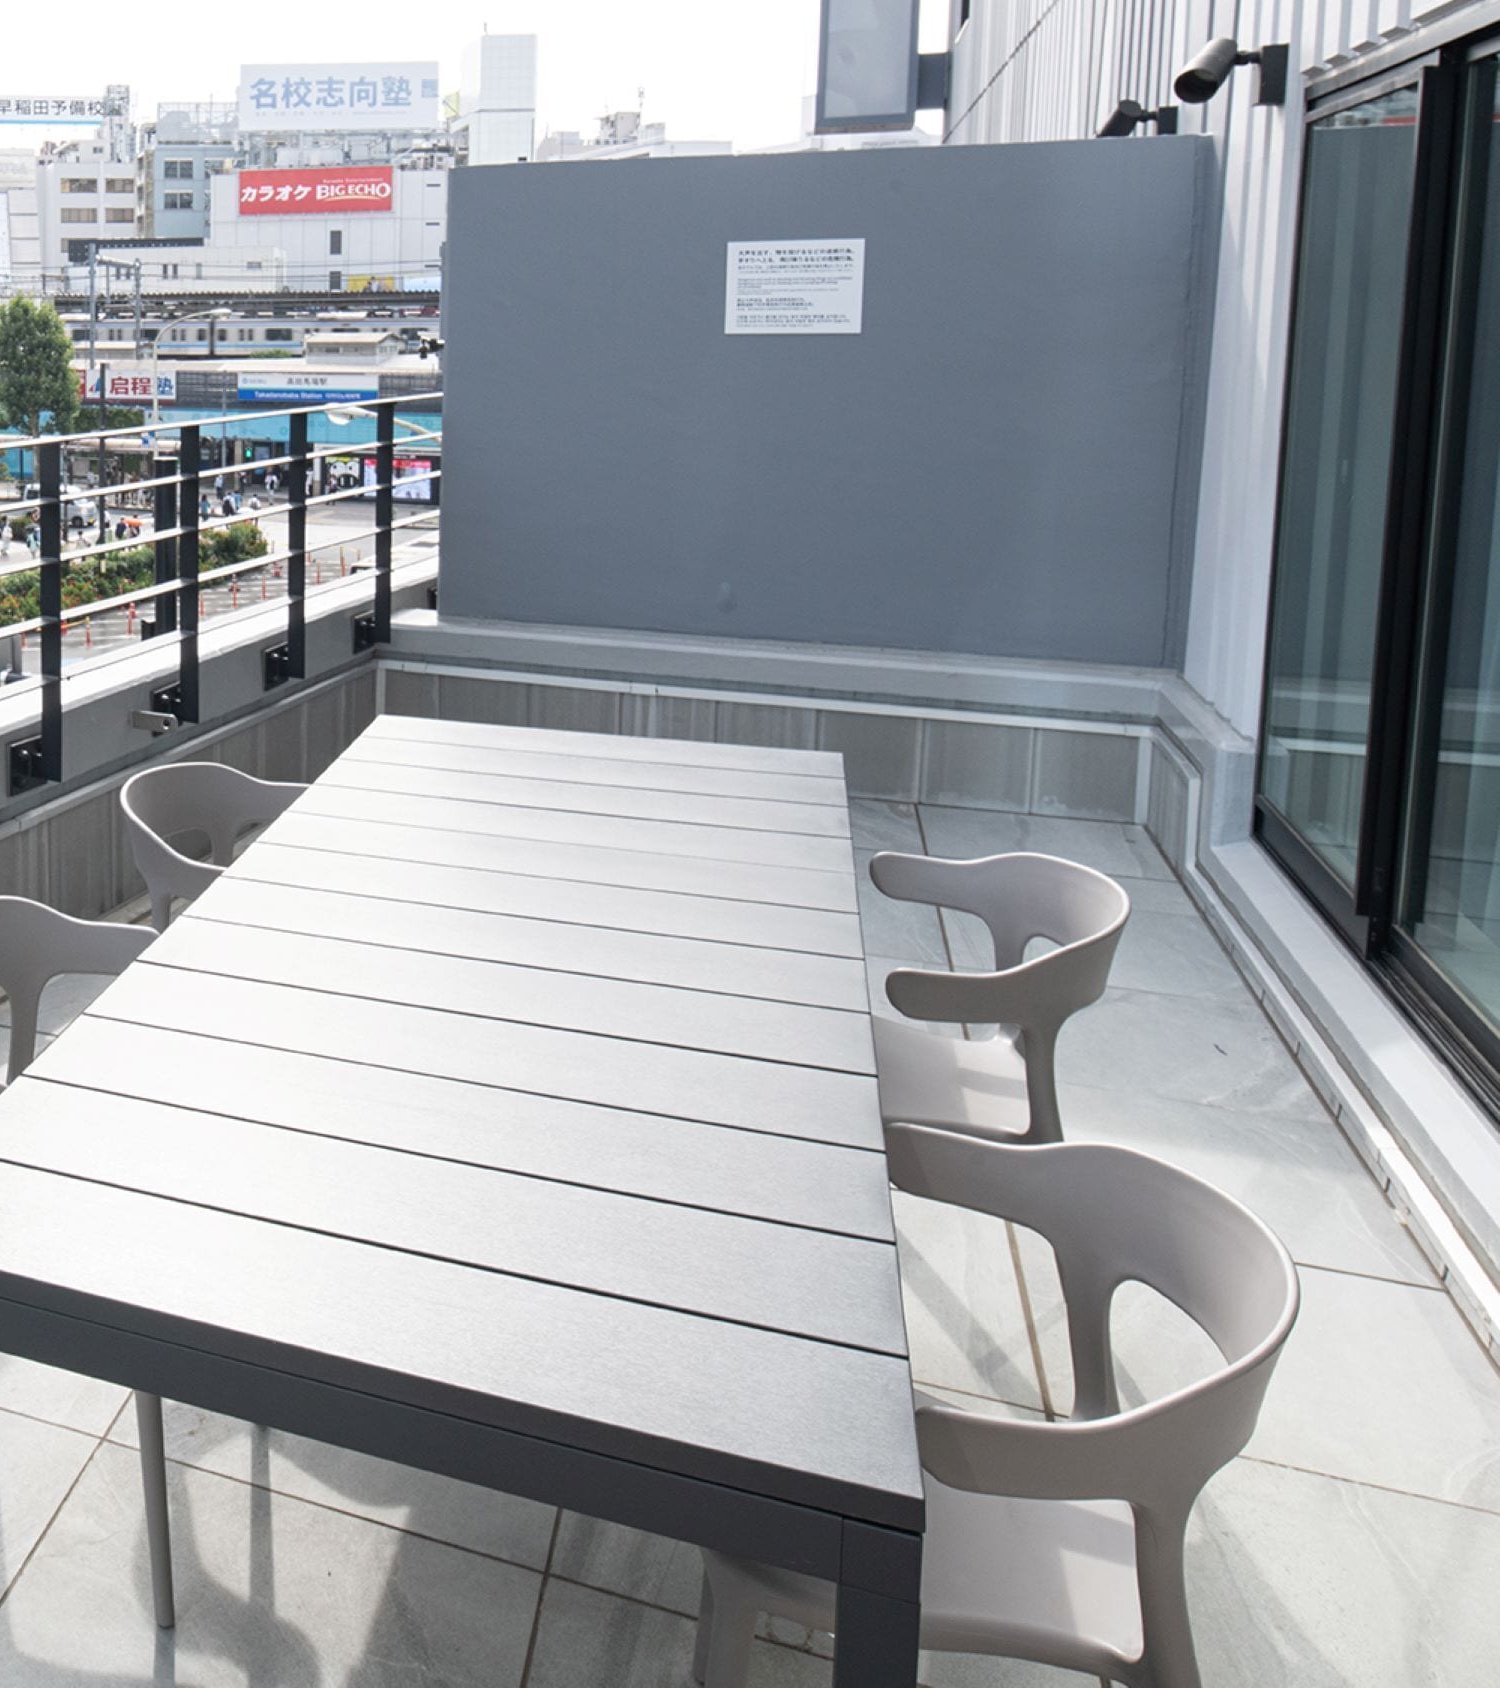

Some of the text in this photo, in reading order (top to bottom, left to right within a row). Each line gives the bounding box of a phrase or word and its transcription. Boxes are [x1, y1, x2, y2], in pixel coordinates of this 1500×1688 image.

[249, 74, 413, 109] 名校志向塾
[240, 184, 313, 203] カラオケ
[315, 182, 392, 202] BIG ECHO
